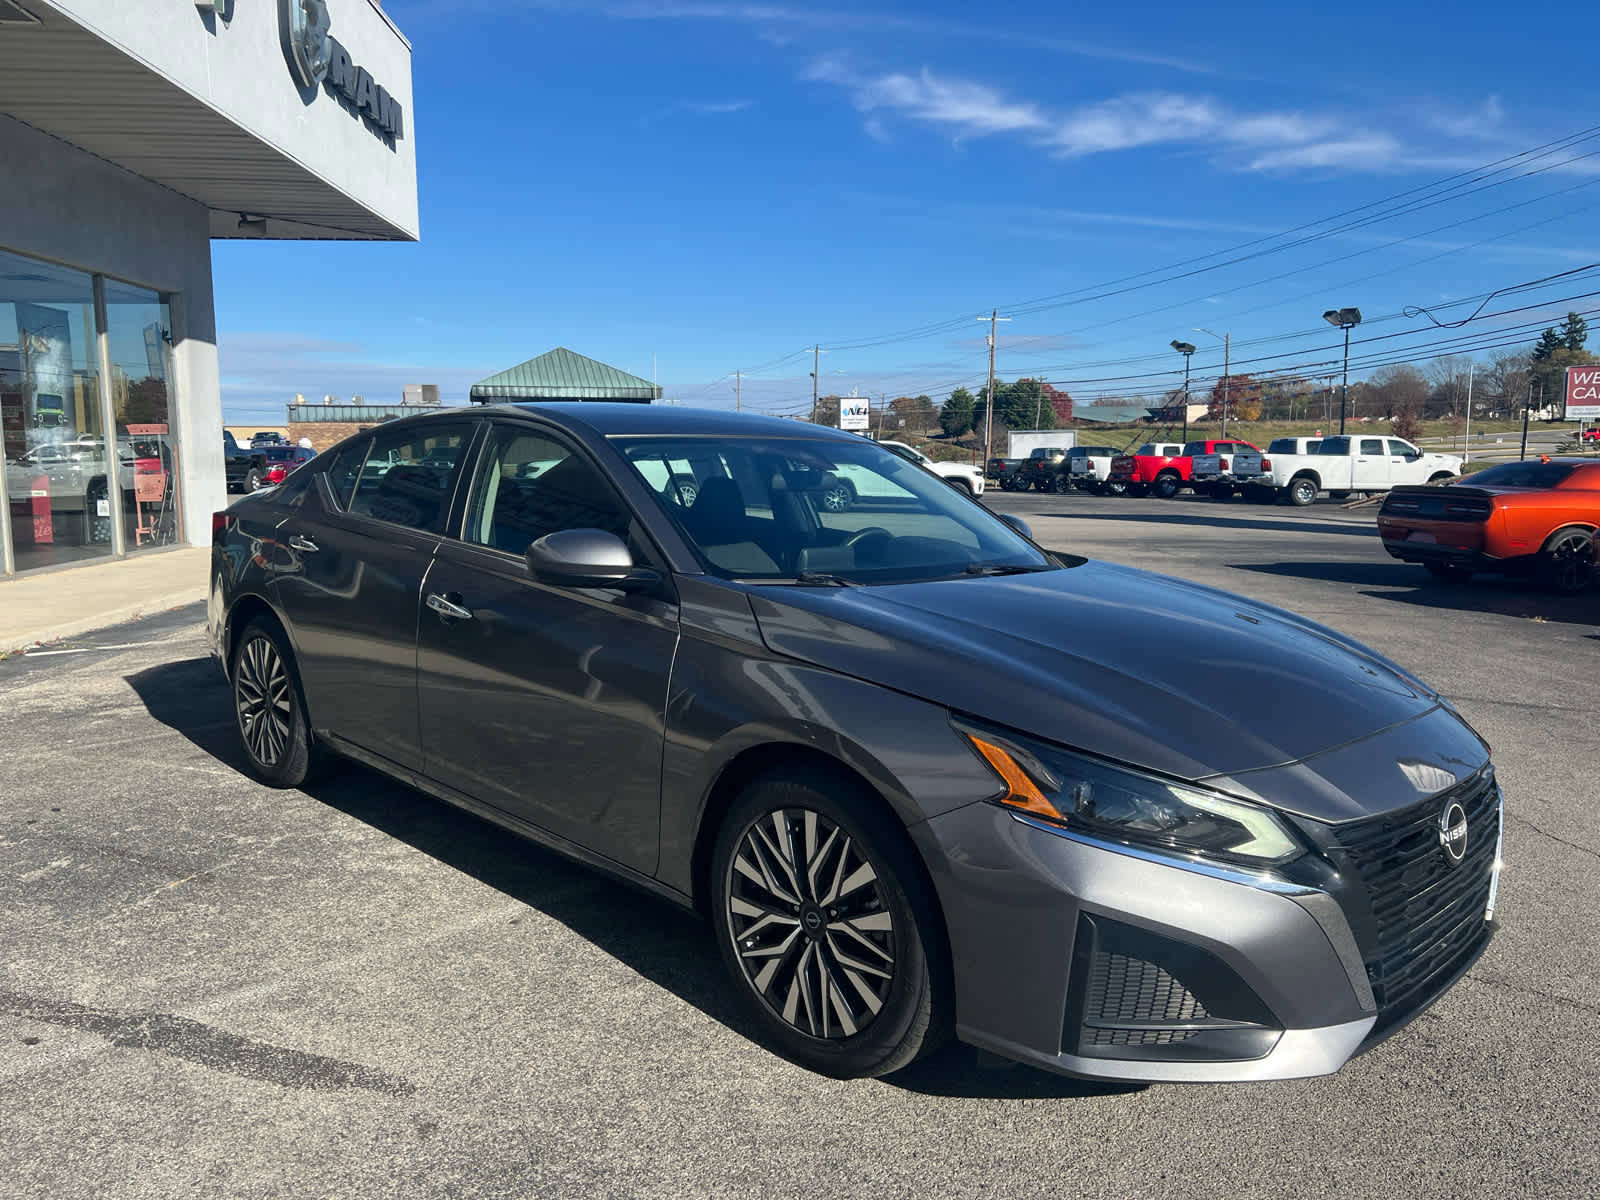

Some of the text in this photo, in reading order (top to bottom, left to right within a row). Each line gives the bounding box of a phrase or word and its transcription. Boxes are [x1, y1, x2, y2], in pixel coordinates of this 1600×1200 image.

[328, 35, 404, 140] RAM
[1572, 386, 1600, 400] CA
[1440, 823, 1467, 846] NISS
